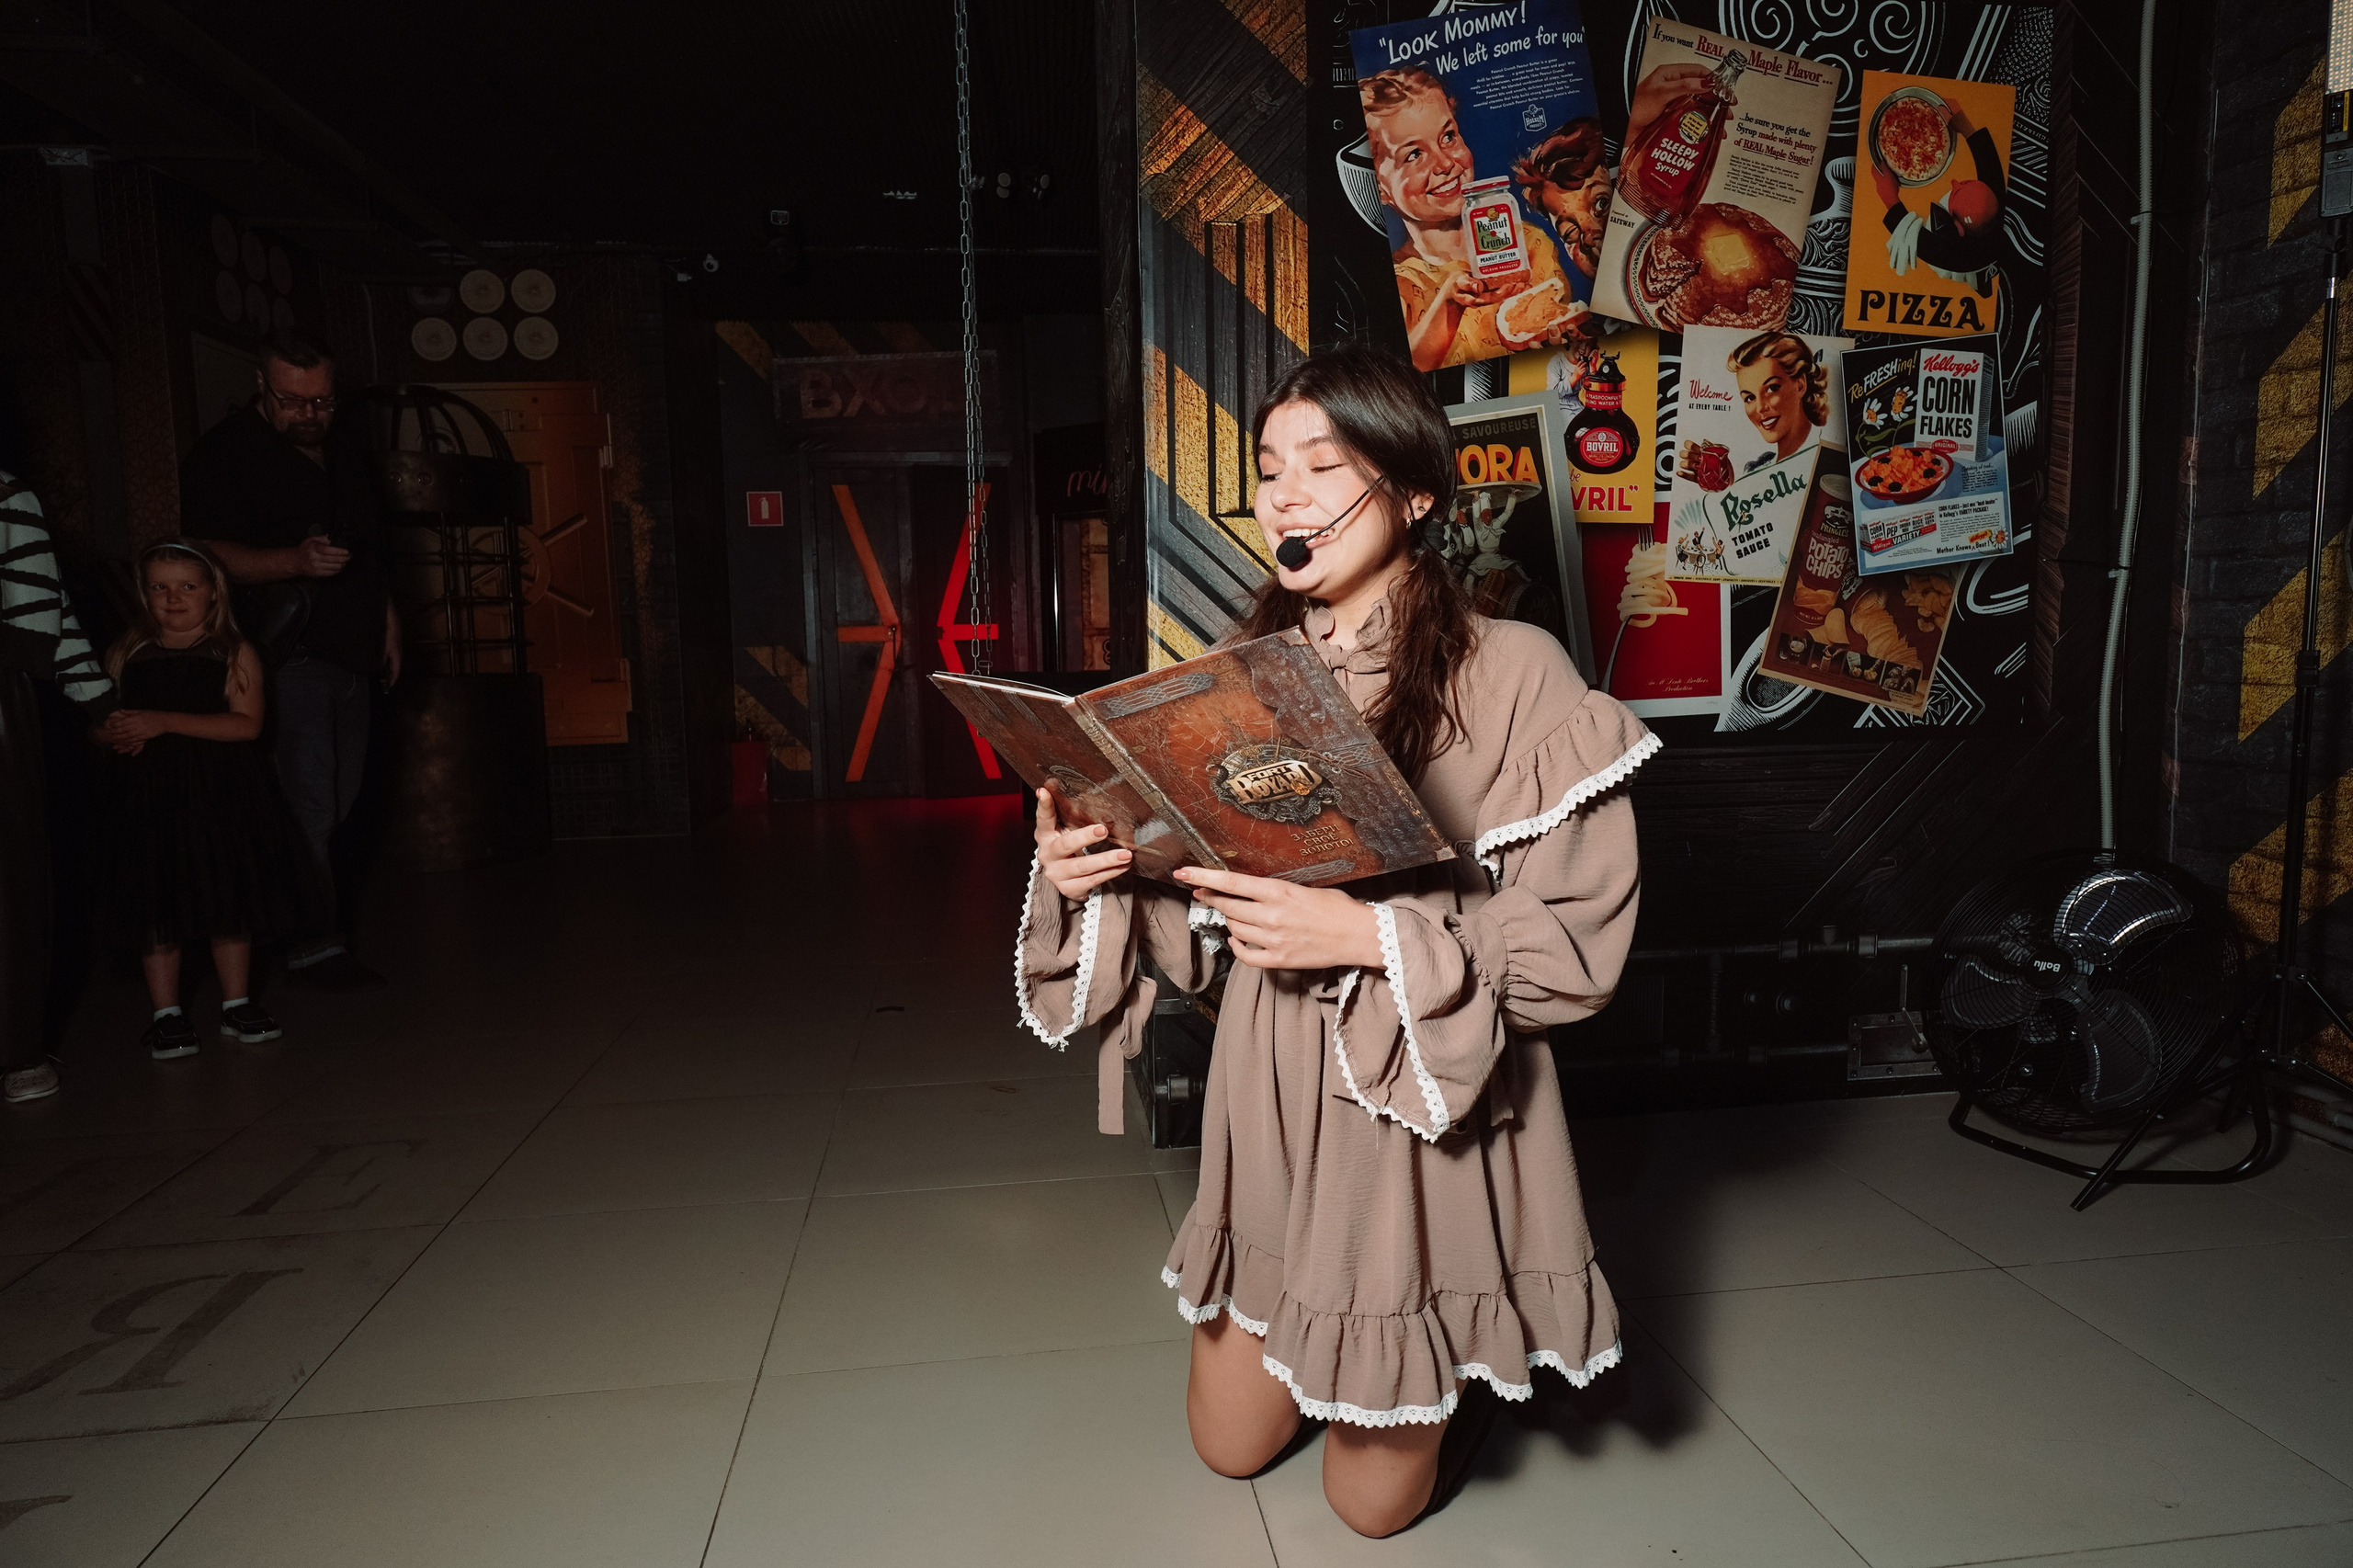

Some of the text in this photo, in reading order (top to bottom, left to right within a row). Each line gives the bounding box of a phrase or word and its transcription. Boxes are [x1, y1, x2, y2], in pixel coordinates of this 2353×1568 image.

[1436, 52, 1459, 74] We
[1463, 44, 1488, 66] left
[1494, 38, 1531, 57] some
[1535, 25, 1558, 46] for
[1653, 23, 1663, 40] If
[1661, 34, 1675, 42] you
[1677, 38, 1694, 48] want
[1696, 34, 1724, 58] REAL
[1746, 50, 1782, 76] Maple
[1736, 122, 1817, 153] Syrup made with plenty
[1755, 119, 1770, 128] sure
[1771, 122, 1785, 131] you
[1785, 126, 1798, 135] get
[1799, 128, 1811, 137] the
[1651, 148, 1695, 172] HOLLOW
[1660, 138, 1699, 160] SLEEPY
[1733, 138, 1814, 165] of REAL Maple Sugar!
[1654, 162, 1680, 176] Syrup
[1477, 218, 1507, 233] Peanut
[1610, 216, 1635, 228] SAFEWAY
[1482, 233, 1511, 249] Crunch
[1480, 255, 1498, 264] PEANUT
[1857, 289, 1985, 332] PIZZA
[1923, 353, 1980, 377] Kellogg's
[800, 366, 965, 420] ВХО
[1689, 379, 1733, 402] Welcome
[1922, 376, 1976, 415] CORN
[1462, 418, 1537, 440] SAVOUREUSE
[1920, 415, 1973, 438] FLAKES
[1586, 442, 1619, 452] BOVRIL
[1455, 443, 1541, 485] ORA
[1570, 469, 1582, 482] be
[1571, 484, 1639, 511] VRIL”
[1720, 471, 1808, 532] Rosella
[1732, 522, 1774, 546] TOMATO
[1887, 526, 1898, 539] PEP
[1893, 529, 1921, 545] VARIETY
[1736, 538, 1770, 559] SAUCE
[1937, 546, 1954, 554] Mother
[1956, 543, 1972, 551] Knows
[1805, 553, 1845, 580] CHIPS
[1246, 766, 1290, 782] FORT
[1290, 824, 1340, 842] ЗАБЕРИ
[1299, 837, 1356, 857] ЗОЛОТО!
[2033, 960, 2062, 972] Ballu
